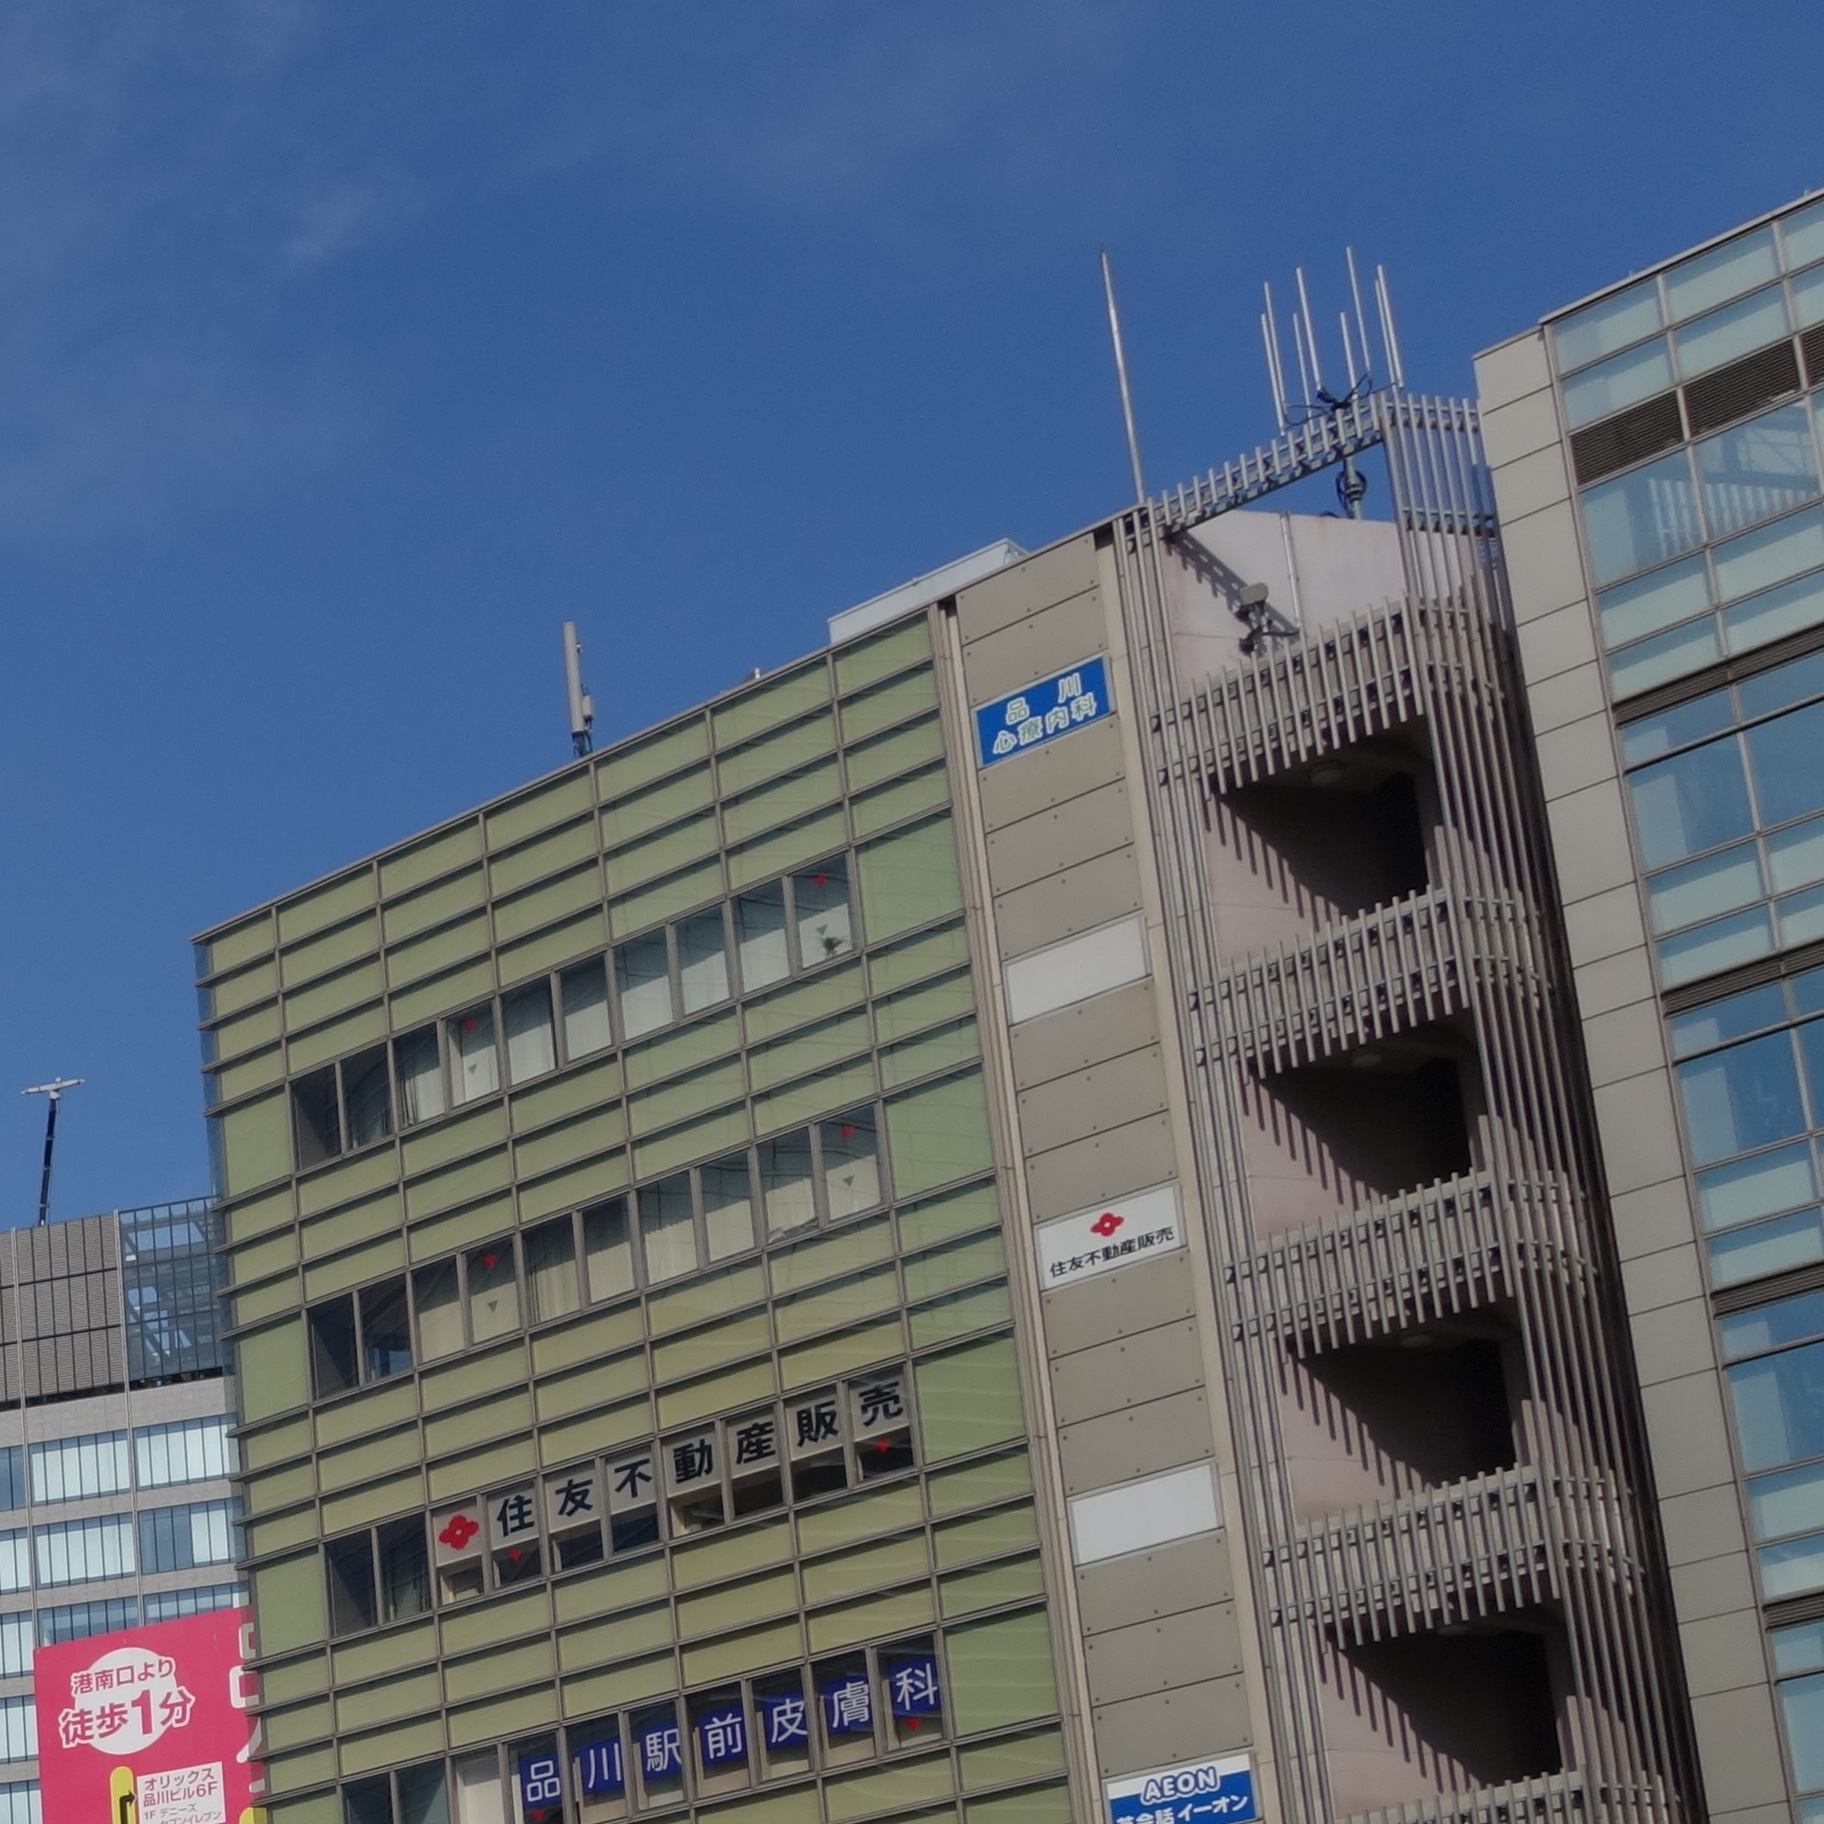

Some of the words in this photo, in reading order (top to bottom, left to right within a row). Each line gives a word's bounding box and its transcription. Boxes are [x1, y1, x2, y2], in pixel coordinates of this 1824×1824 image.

[993, 692, 1097, 754] 心療内科
[1006, 673, 1082, 725] 品川
[1049, 1227, 1175, 1279] 住友不動産販売
[498, 1382, 904, 1537] 住友不動産販売
[74, 1659, 173, 1693] 港南口より
[62, 1690, 192, 1745] 徒歩1分
[526, 1664, 937, 1802] 品川駅前皮膚科
[144, 1781, 218, 1807] 品川ビル6F
[145, 1768, 215, 1791] オリックス
[1143, 1766, 1216, 1802] AEON
